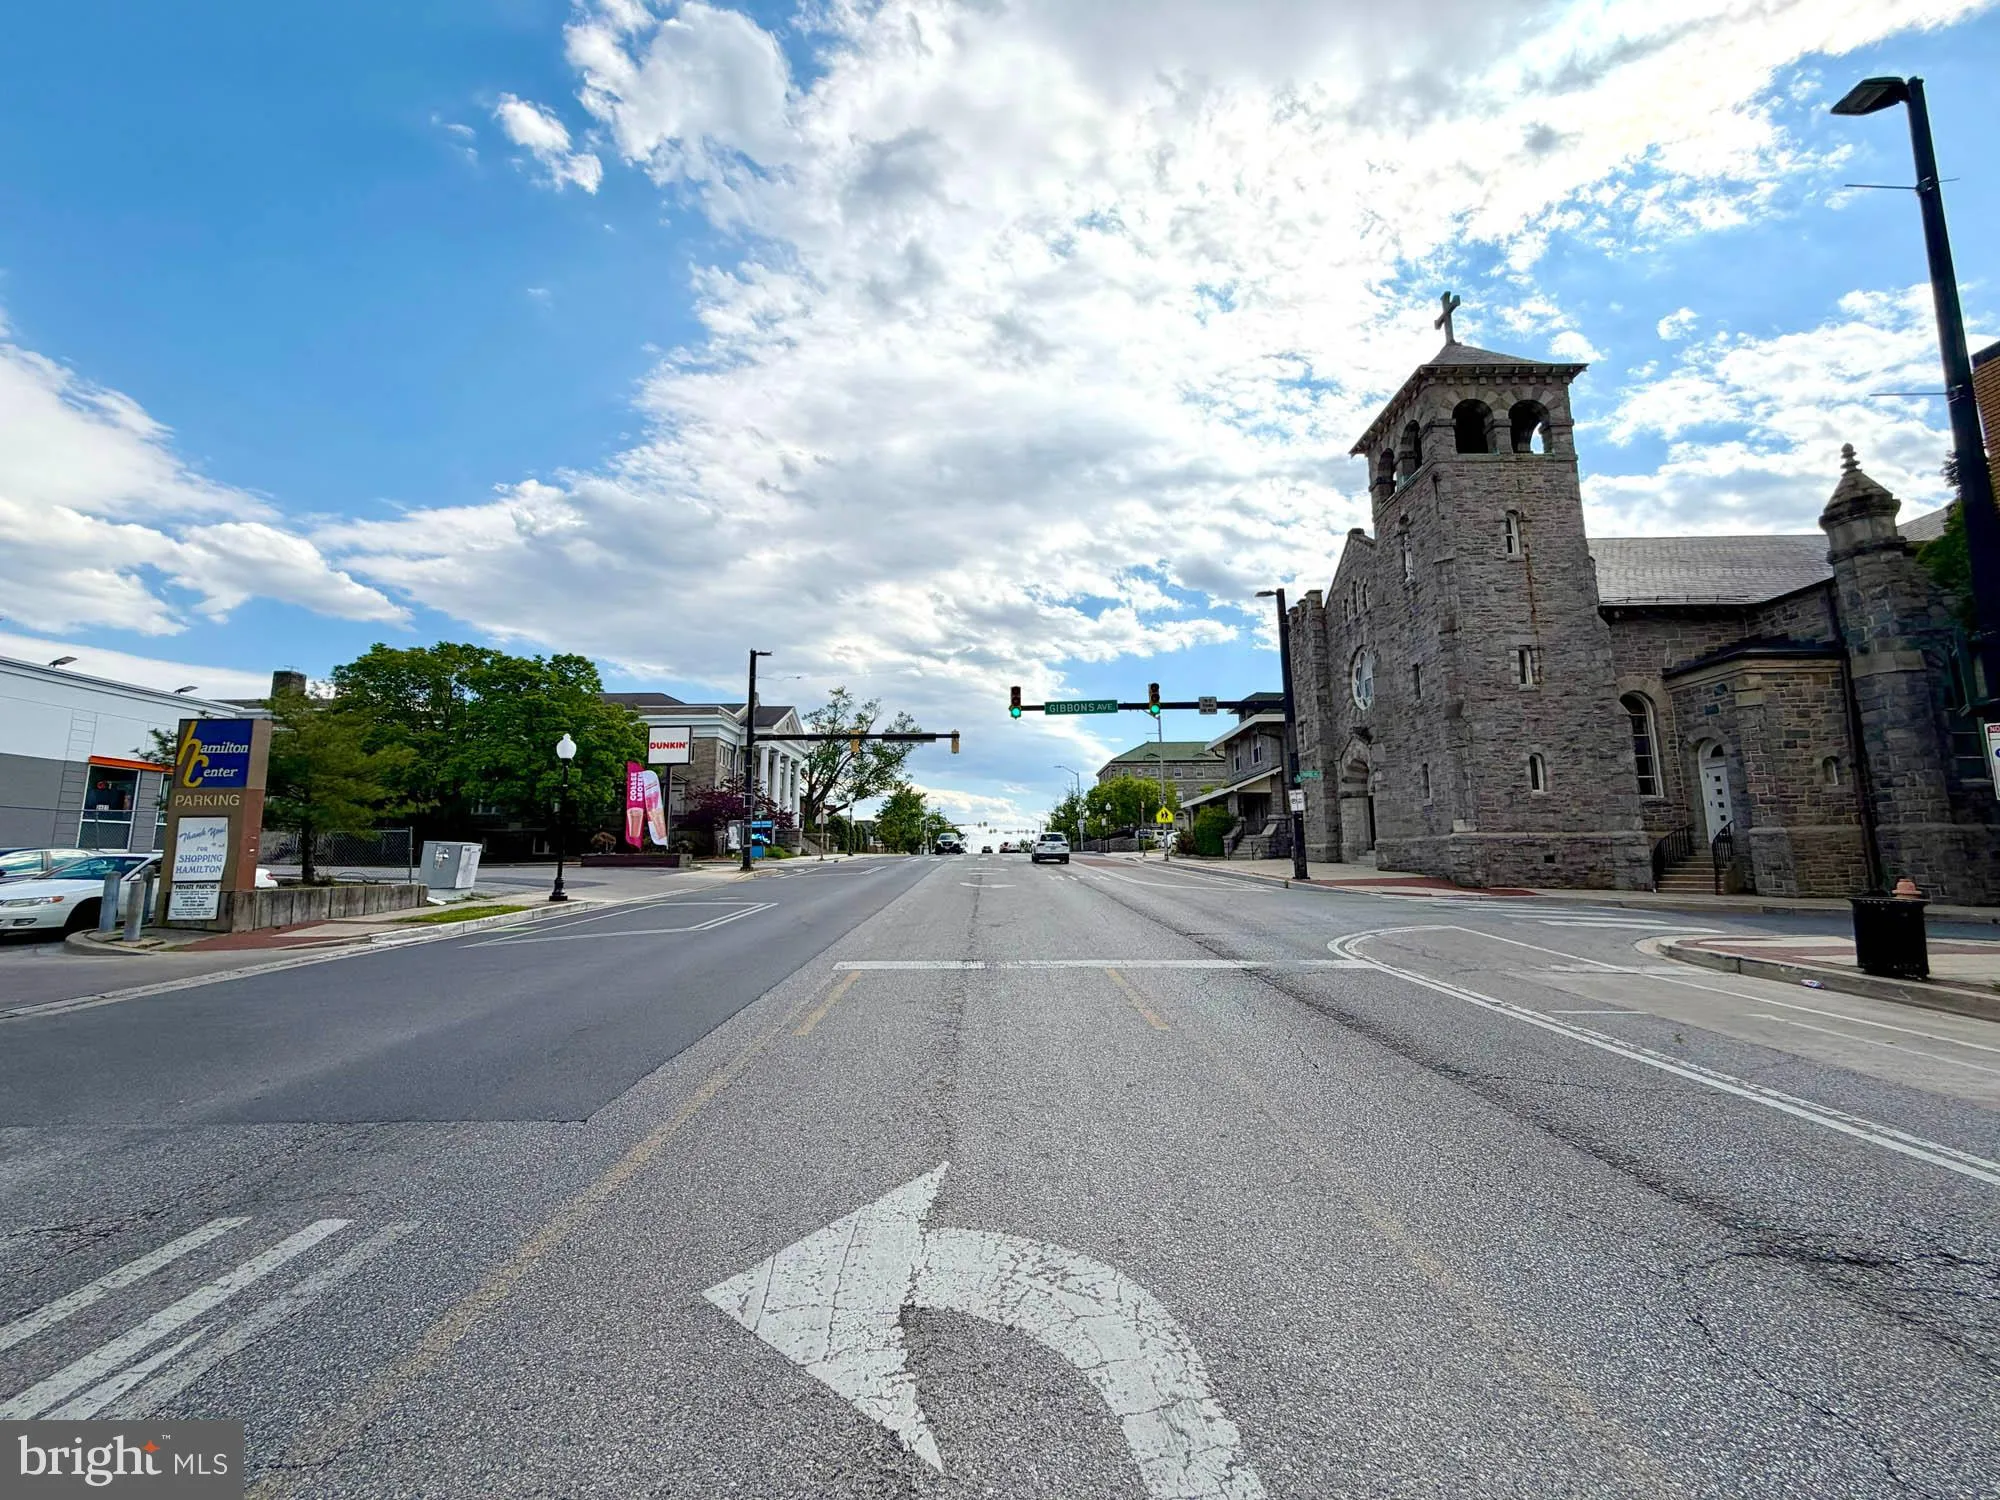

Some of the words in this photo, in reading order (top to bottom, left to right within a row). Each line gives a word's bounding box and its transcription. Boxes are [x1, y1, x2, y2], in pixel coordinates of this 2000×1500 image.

[1049, 703, 1095, 713] GIBBONS
[650, 741, 688, 749] DUNKIN'
[175, 795, 240, 806] PARKING
[179, 827, 206, 843] Thank
[179, 854, 223, 863] SHOPPING
[175, 865, 221, 874] HAMILTON
